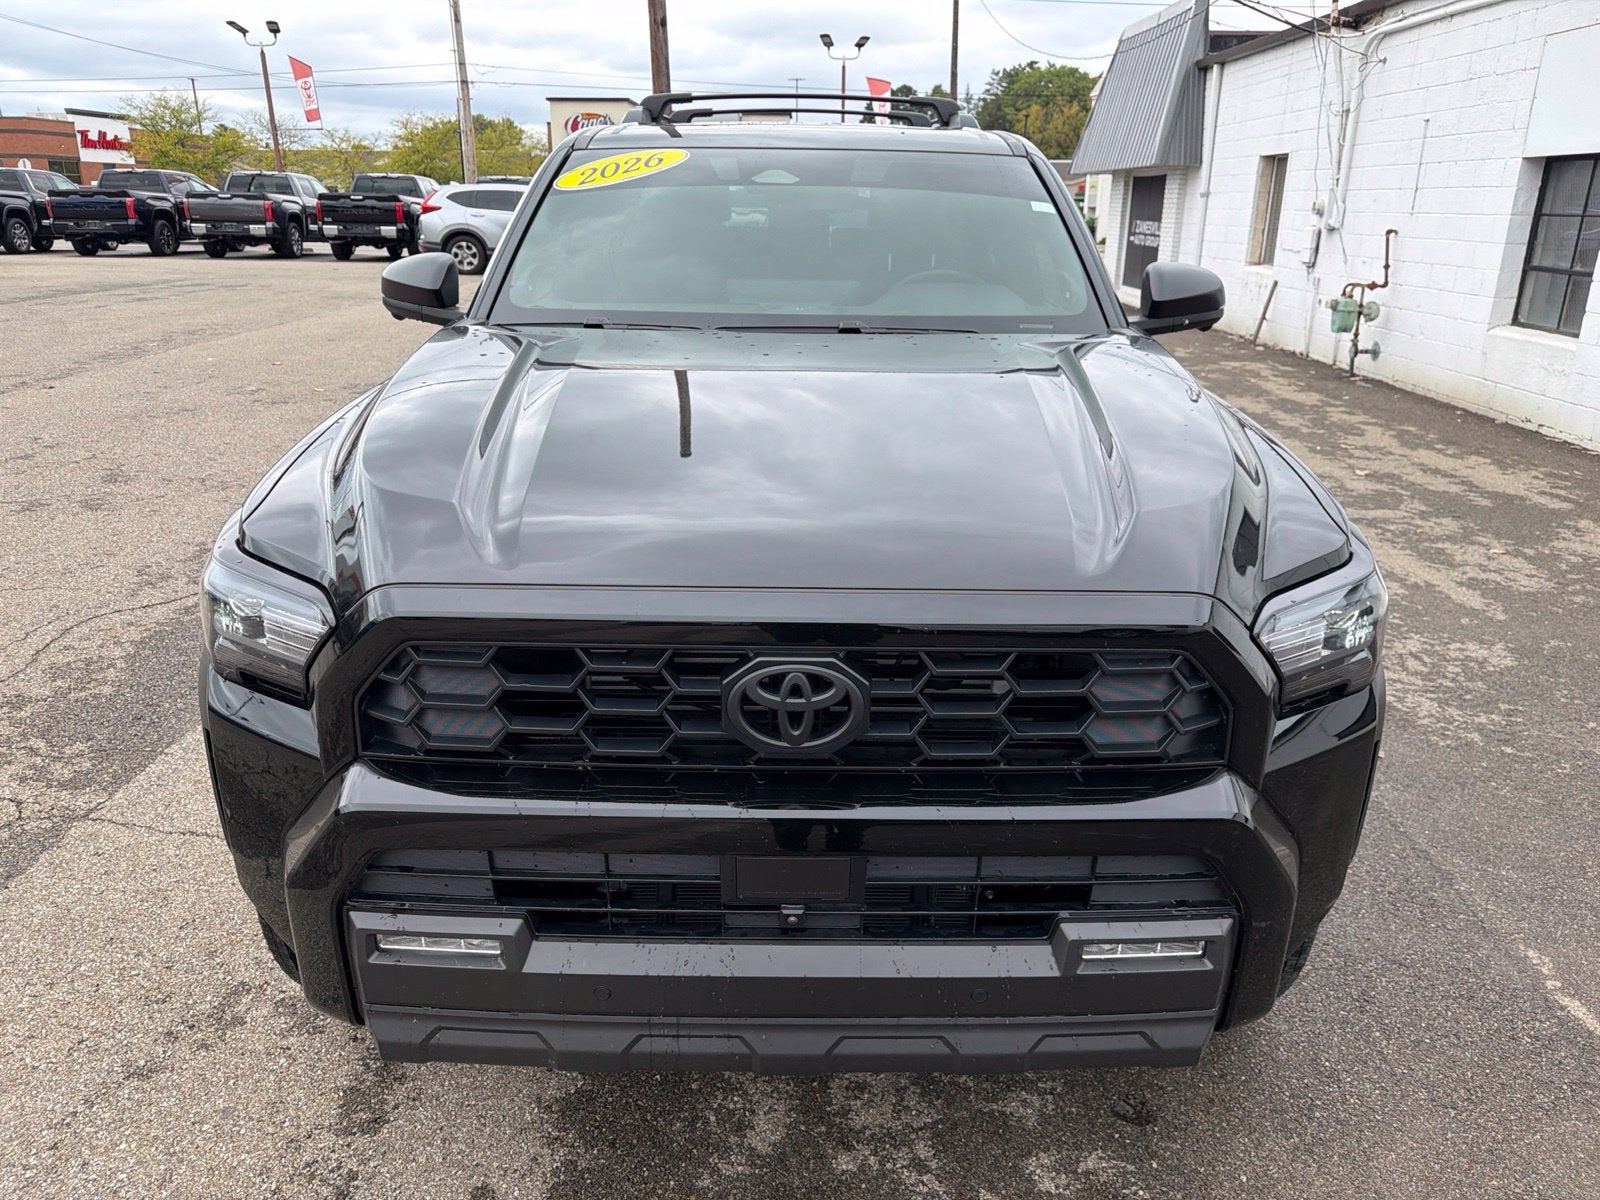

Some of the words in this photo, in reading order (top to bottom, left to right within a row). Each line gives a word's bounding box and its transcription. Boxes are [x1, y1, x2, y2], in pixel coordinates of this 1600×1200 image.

[564, 111, 613, 135] Cane's
[77, 129, 98, 150] Tim
[578, 151, 665, 186] 2026
